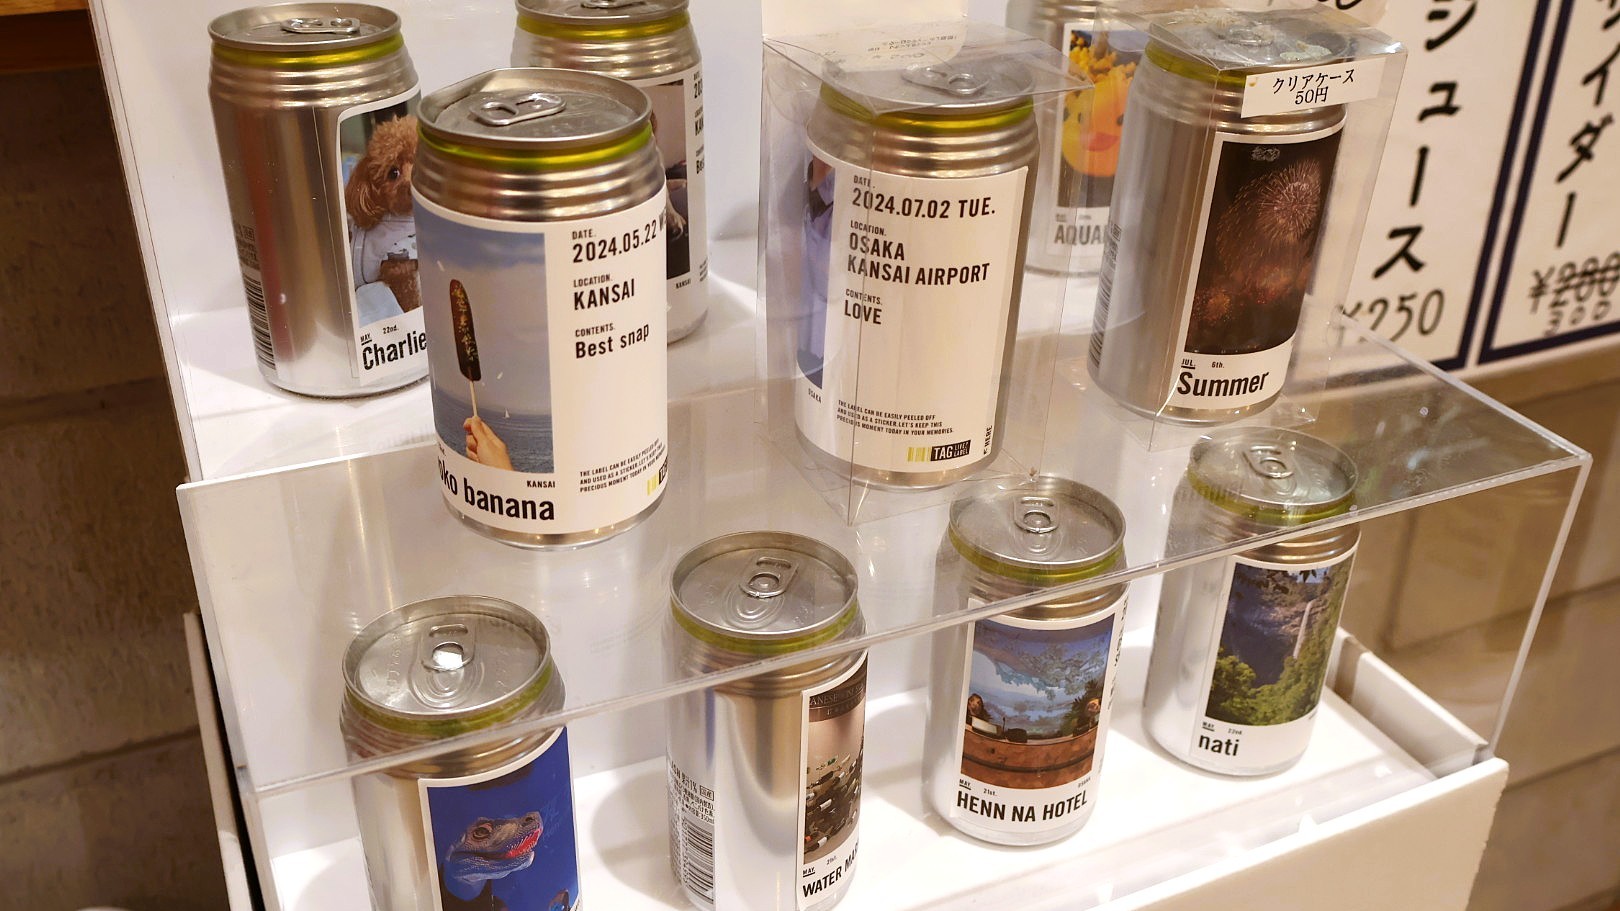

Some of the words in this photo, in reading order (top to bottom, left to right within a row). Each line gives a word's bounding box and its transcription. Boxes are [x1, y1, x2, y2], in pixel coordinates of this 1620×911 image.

[1272, 68, 1355, 95] クリアケース
[1295, 85, 1329, 105] 50円
[852, 188, 951, 219] 2024.07.02
[958, 197, 996, 218] TUE.
[573, 219, 657, 263] 2024.05.22
[849, 232, 906, 261] OSAKA
[847, 254, 910, 284] KANSAI
[914, 262, 990, 286] AIRPORT
[574, 278, 635, 311] KANSAI
[844, 299, 883, 325] LOVE
[362, 331, 427, 370] Charlie
[576, 336, 613, 359] Best
[620, 324, 650, 349] snap
[1177, 371, 1270, 397] Summer
[864, 408, 875, 416] CAN
[884, 412, 902, 420] EASILY
[862, 423, 884, 432] MOMENT
[933, 446, 953, 460] TAG
[954, 448, 969, 458] LABEL
[580, 482, 608, 492] PRECIOUS
[608, 476, 629, 486] MOMENT
[592, 466, 608, 476] LABEL
[592, 473, 607, 482] USED
[526, 480, 556, 489] KANSAI
[464, 477, 555, 521] banana
[1198, 734, 1240, 756] nati
[957, 790, 1006, 821] HENN
[1011, 805, 1036, 822] NA
[1042, 790, 1088, 821] HOTEL
[803, 865, 842, 898] WATER
